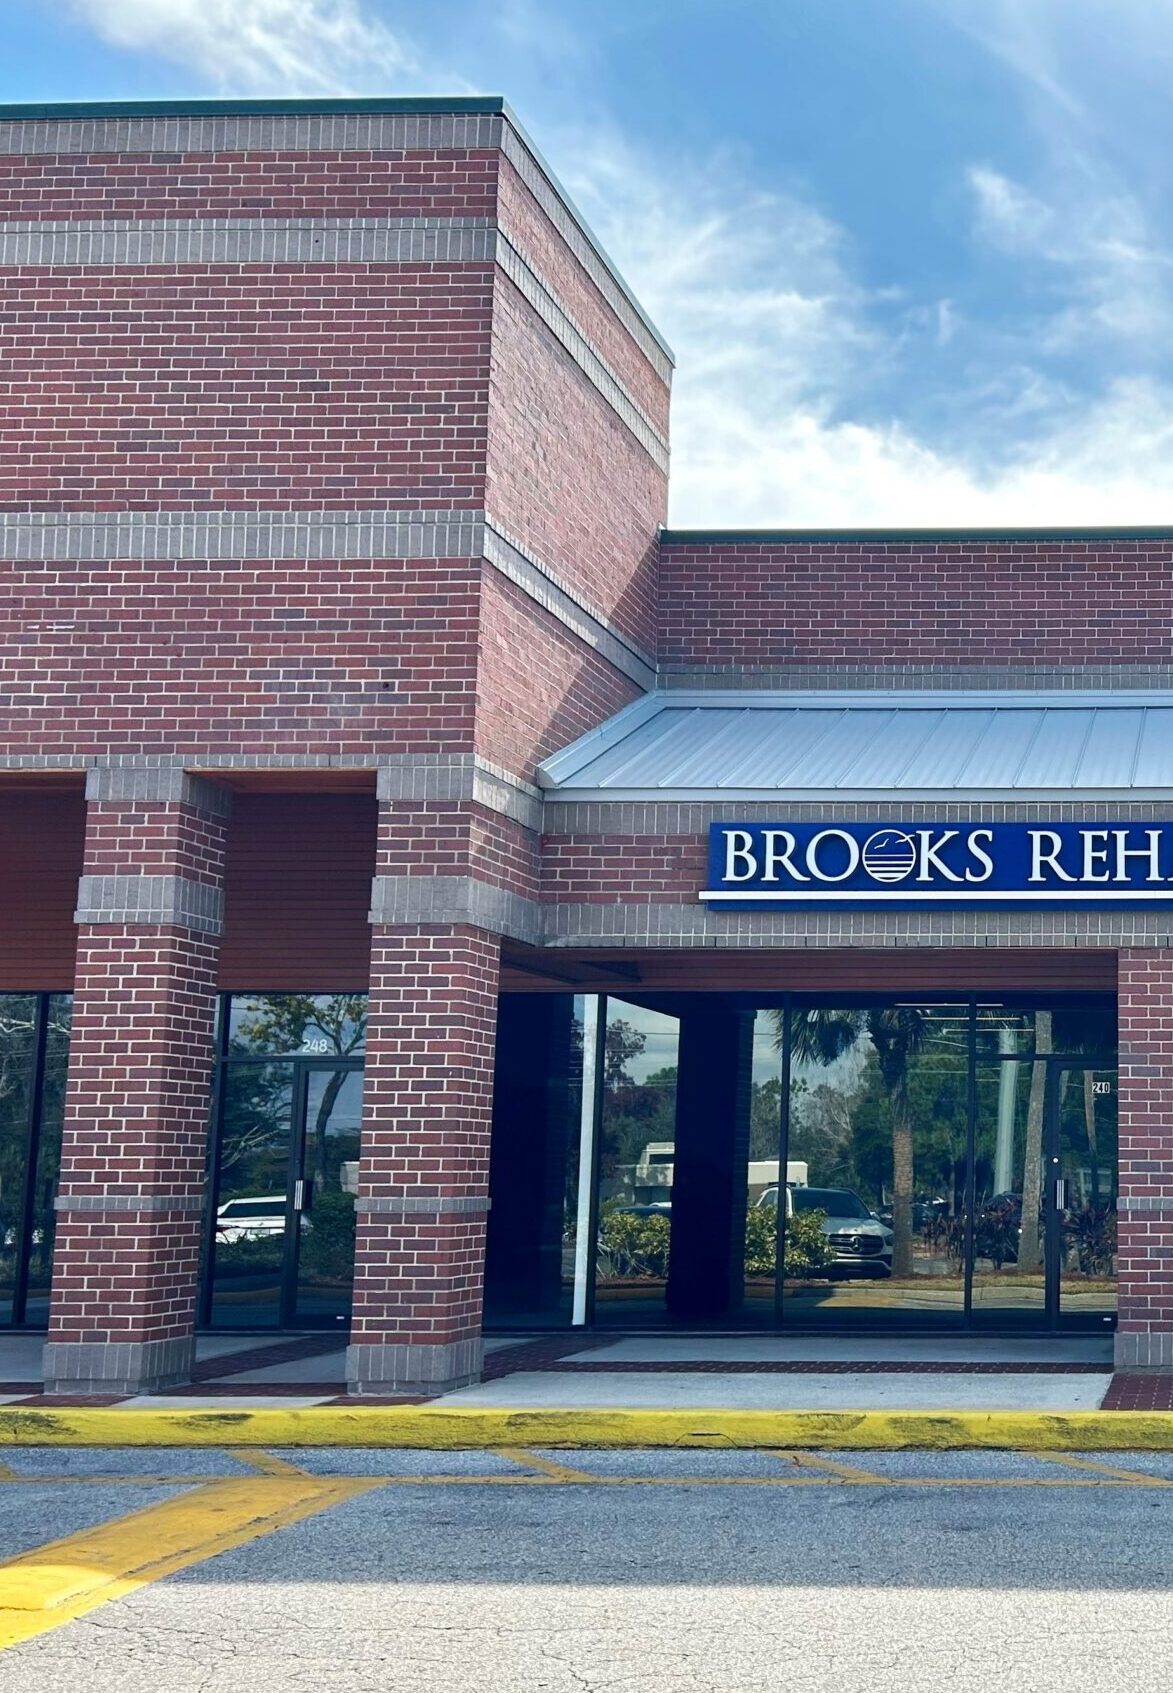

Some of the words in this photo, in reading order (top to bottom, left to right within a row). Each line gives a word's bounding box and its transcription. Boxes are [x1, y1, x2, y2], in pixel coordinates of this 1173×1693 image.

[721, 828, 994, 883] BROOKS
[302, 1038, 328, 1053] 248
[1092, 1082, 1110, 1093] 240
